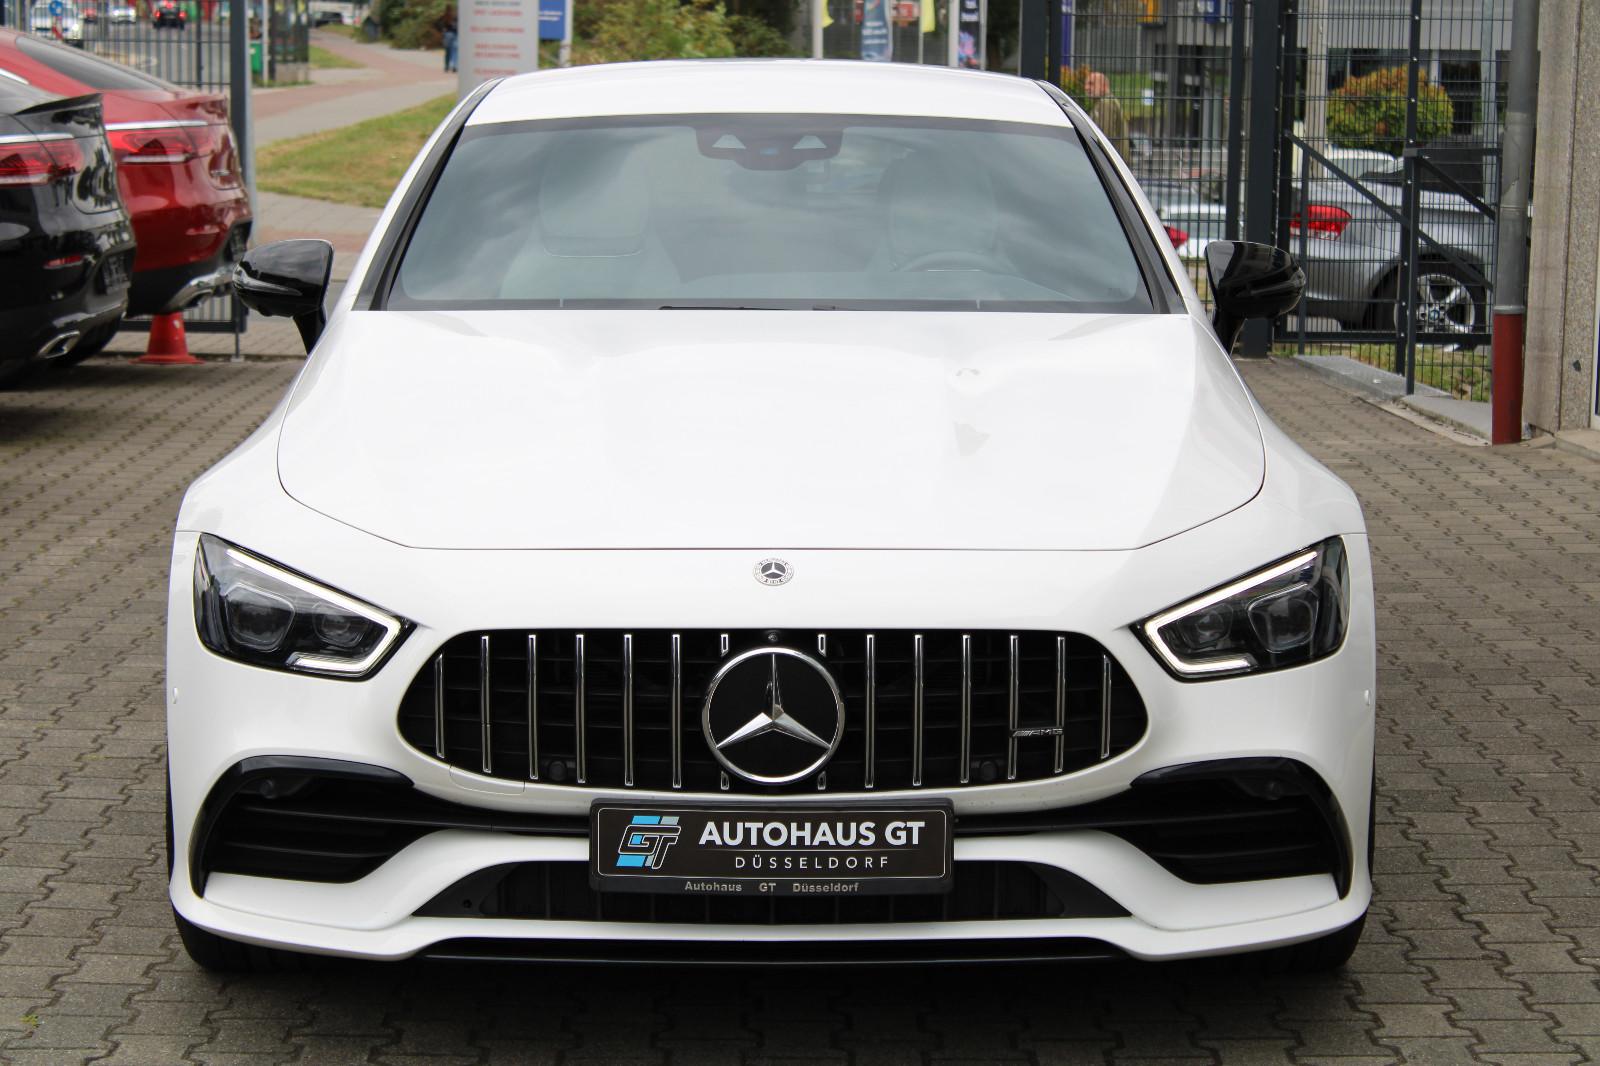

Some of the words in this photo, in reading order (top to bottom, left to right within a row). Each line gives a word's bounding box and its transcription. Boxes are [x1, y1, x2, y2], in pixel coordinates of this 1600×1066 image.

[699, 821, 876, 847] AUTOHAUS
[884, 821, 926, 847] GT
[734, 854, 889, 869] DÜSSELDORF
[684, 881, 743, 893] Autohaus
[758, 882, 776, 893] GT
[792, 881, 860, 893] Düsseldorf
